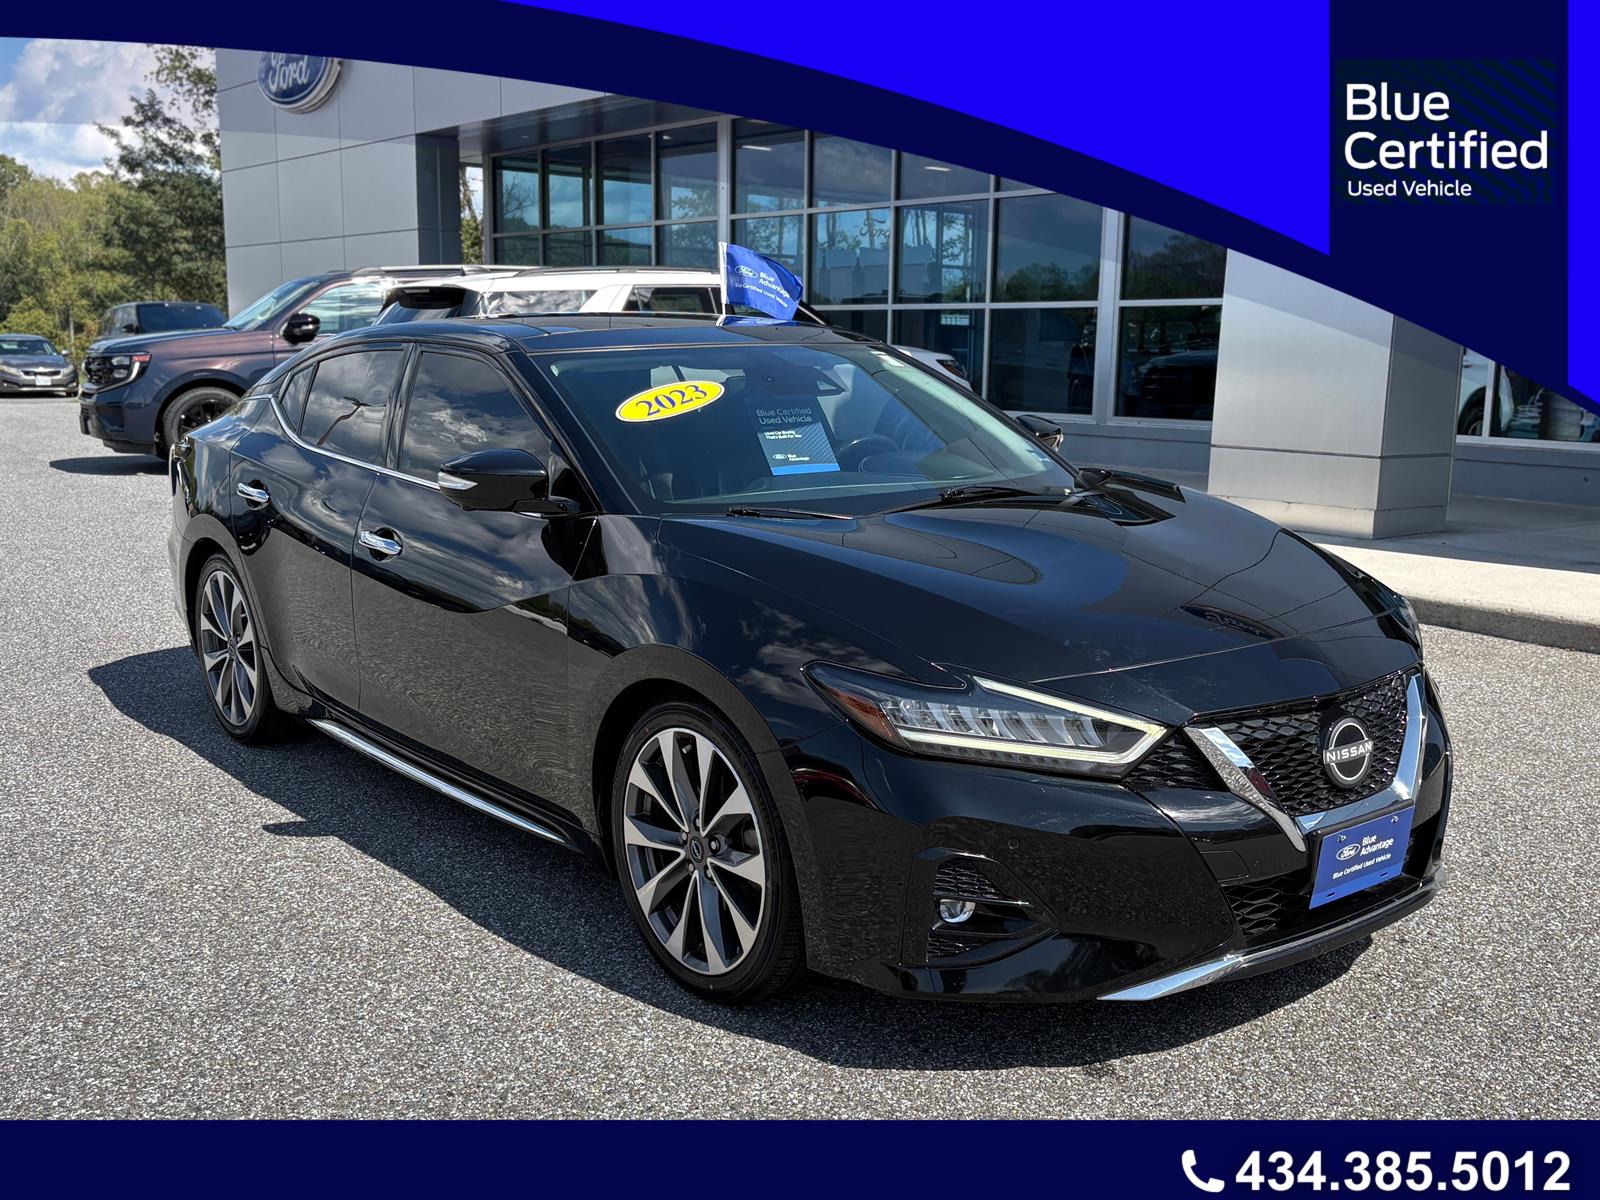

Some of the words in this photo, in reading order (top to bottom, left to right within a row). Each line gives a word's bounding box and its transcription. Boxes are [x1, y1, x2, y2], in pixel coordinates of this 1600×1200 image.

[268, 52, 310, 93] Ford
[759, 271, 775, 283] Blue
[636, 384, 707, 416] 2023
[755, 408, 776, 417] Blue
[776, 407, 812, 416] Certified
[758, 416, 781, 425] Used
[781, 415, 813, 423] Vehicle
[1326, 741, 1373, 761] NISSAN
[1360, 838, 1394, 856] Advantage
[1362, 835, 1377, 846] Blue
[1332, 871, 1343, 880] Blue
[1343, 862, 1363, 875] Certified
[1363, 858, 1375, 868] Used
[1375, 853, 1391, 863] Vehicle
